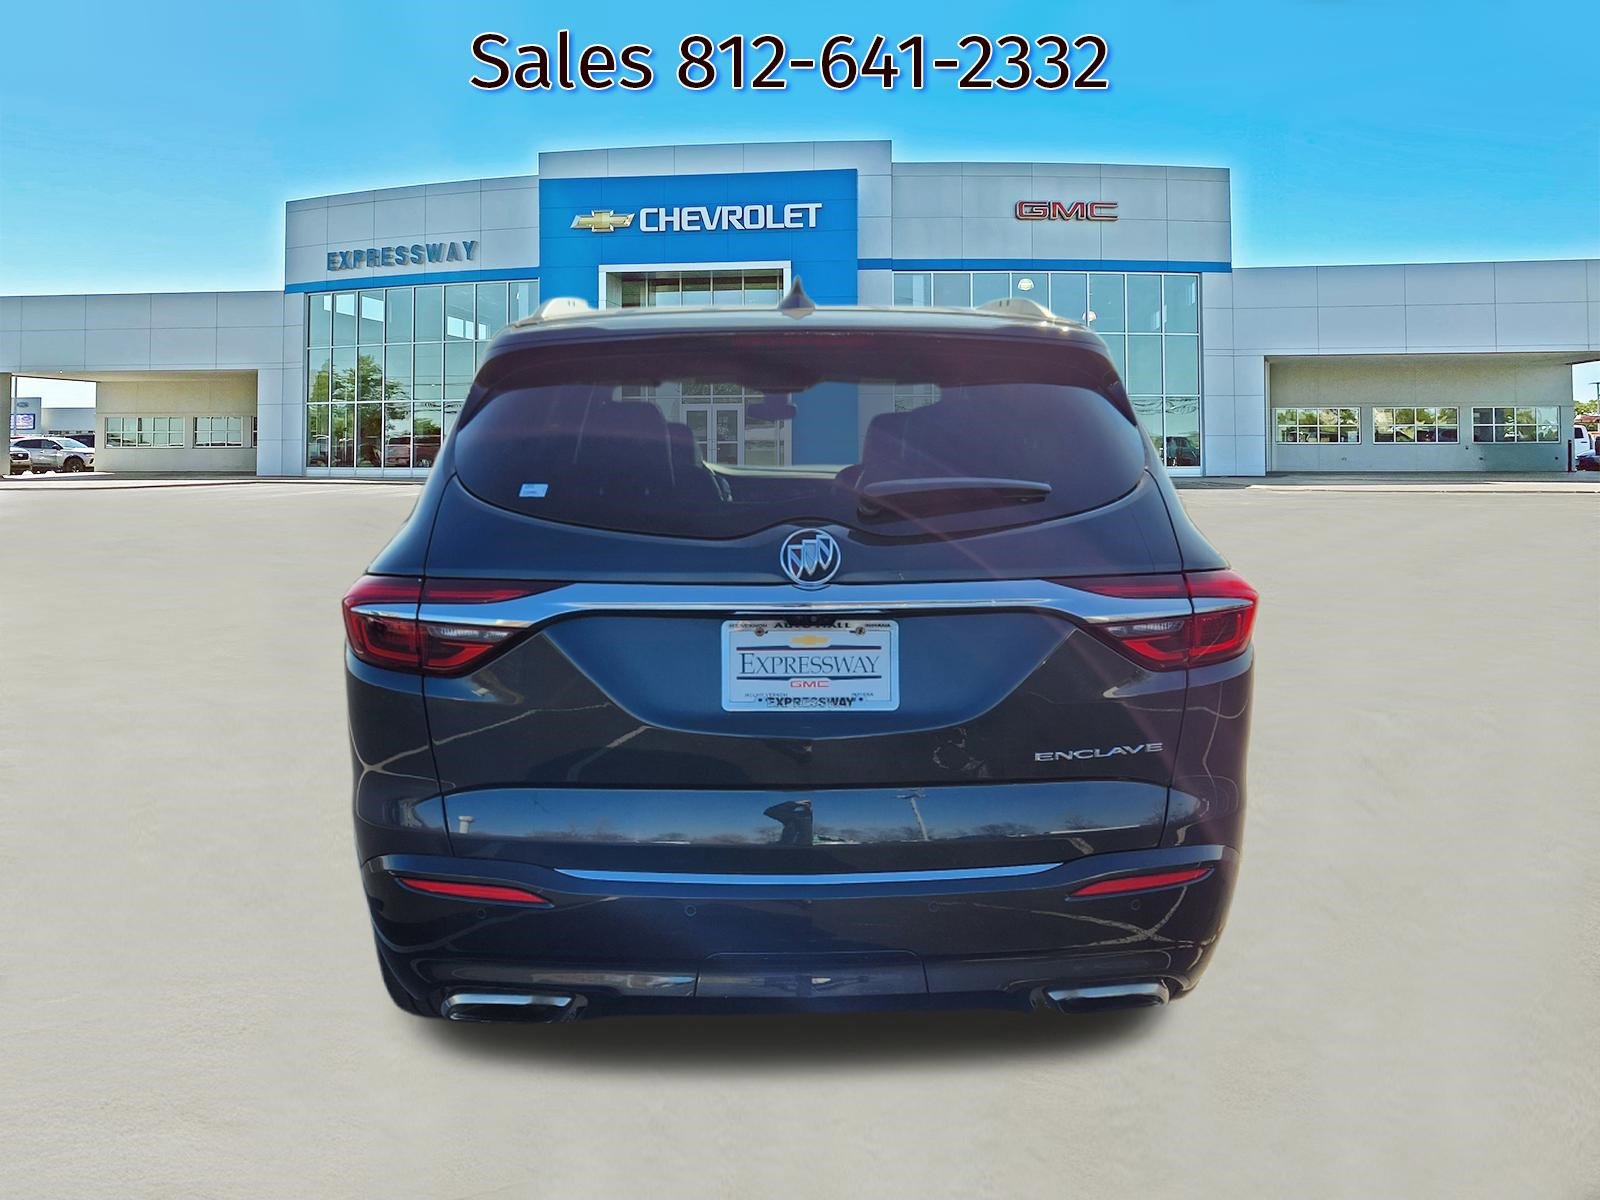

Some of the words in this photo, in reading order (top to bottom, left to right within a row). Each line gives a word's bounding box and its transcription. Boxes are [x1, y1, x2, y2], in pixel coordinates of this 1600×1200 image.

[638, 203, 823, 232] CHEVROLET
[1014, 200, 1119, 221] GMC
[327, 240, 479, 271] EXPRESSWAY
[739, 652, 880, 675] EXPRESSWAY
[790, 680, 830, 688] GMC
[1034, 742, 1164, 762] ENCLAVE
